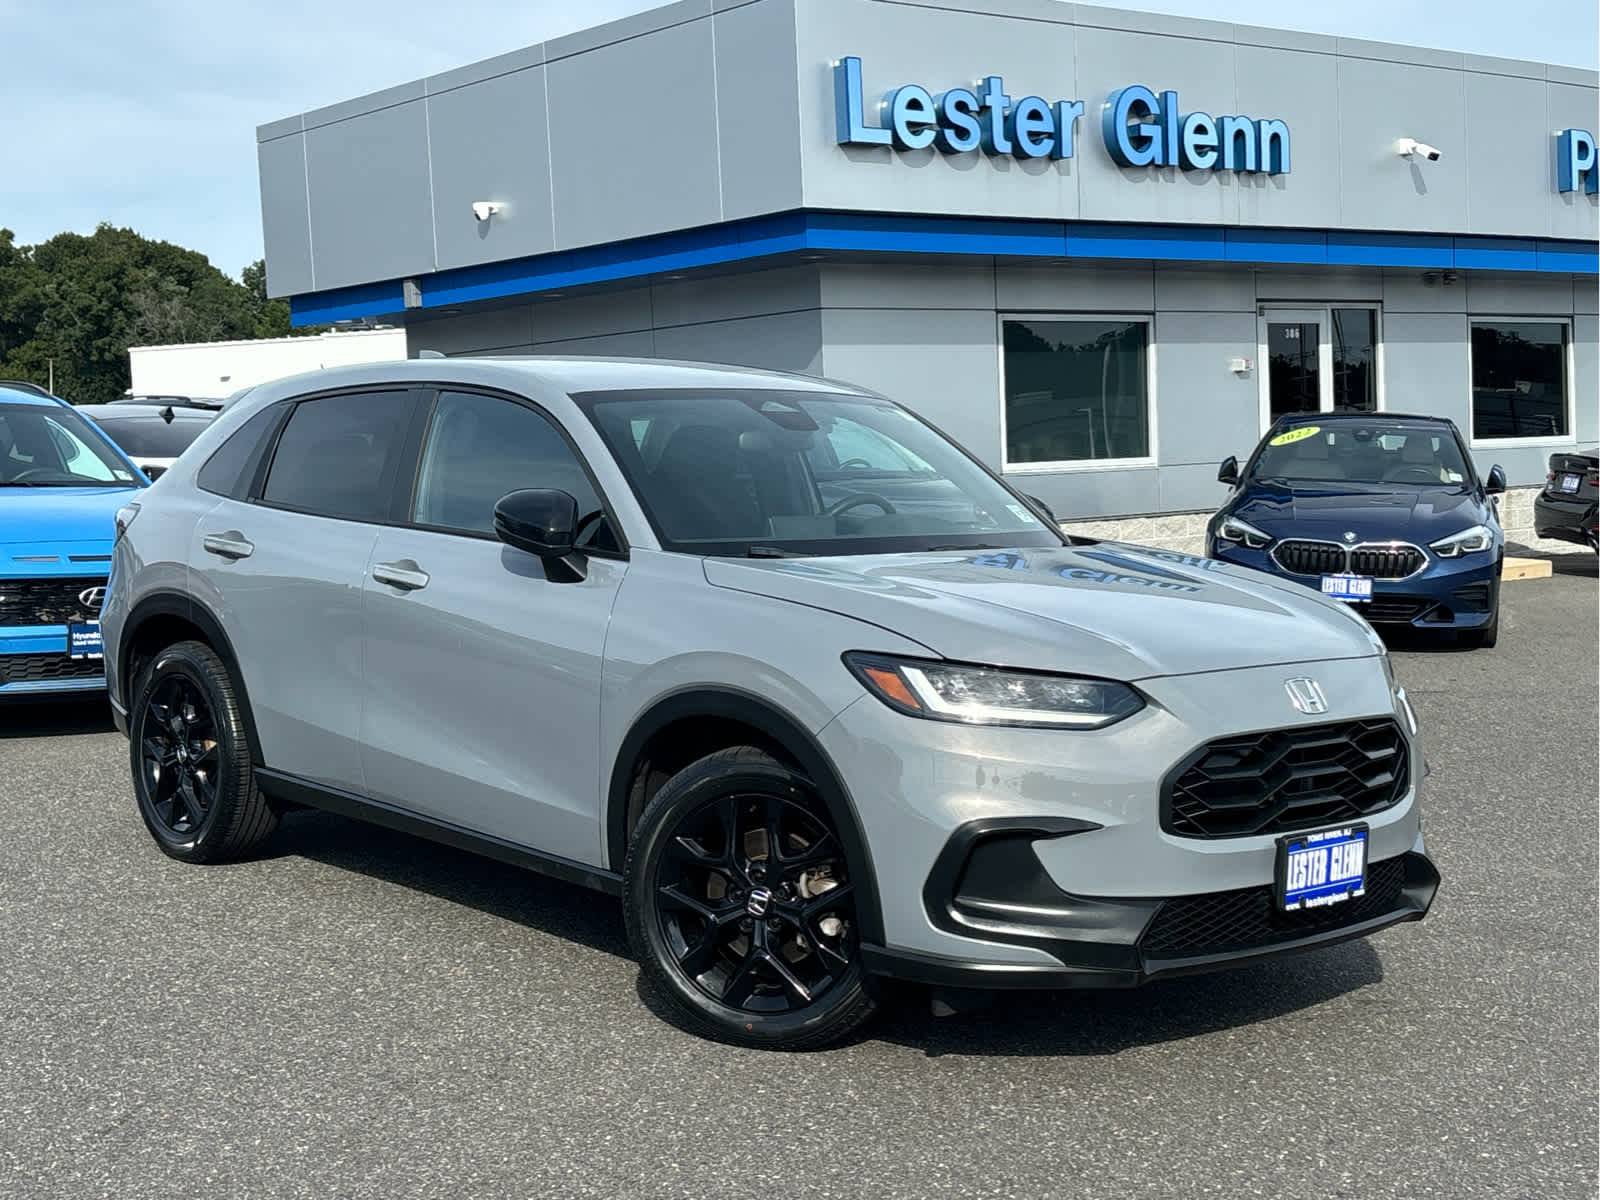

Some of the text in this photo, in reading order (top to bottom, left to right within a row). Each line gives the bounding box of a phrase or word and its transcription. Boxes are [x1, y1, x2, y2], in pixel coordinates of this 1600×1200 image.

[833, 56, 1291, 176] Lester Glenn
[1557, 128, 1598, 195] P
[1279, 427, 1313, 443] 2022
[1286, 841, 1364, 891] LESTER GLENN
